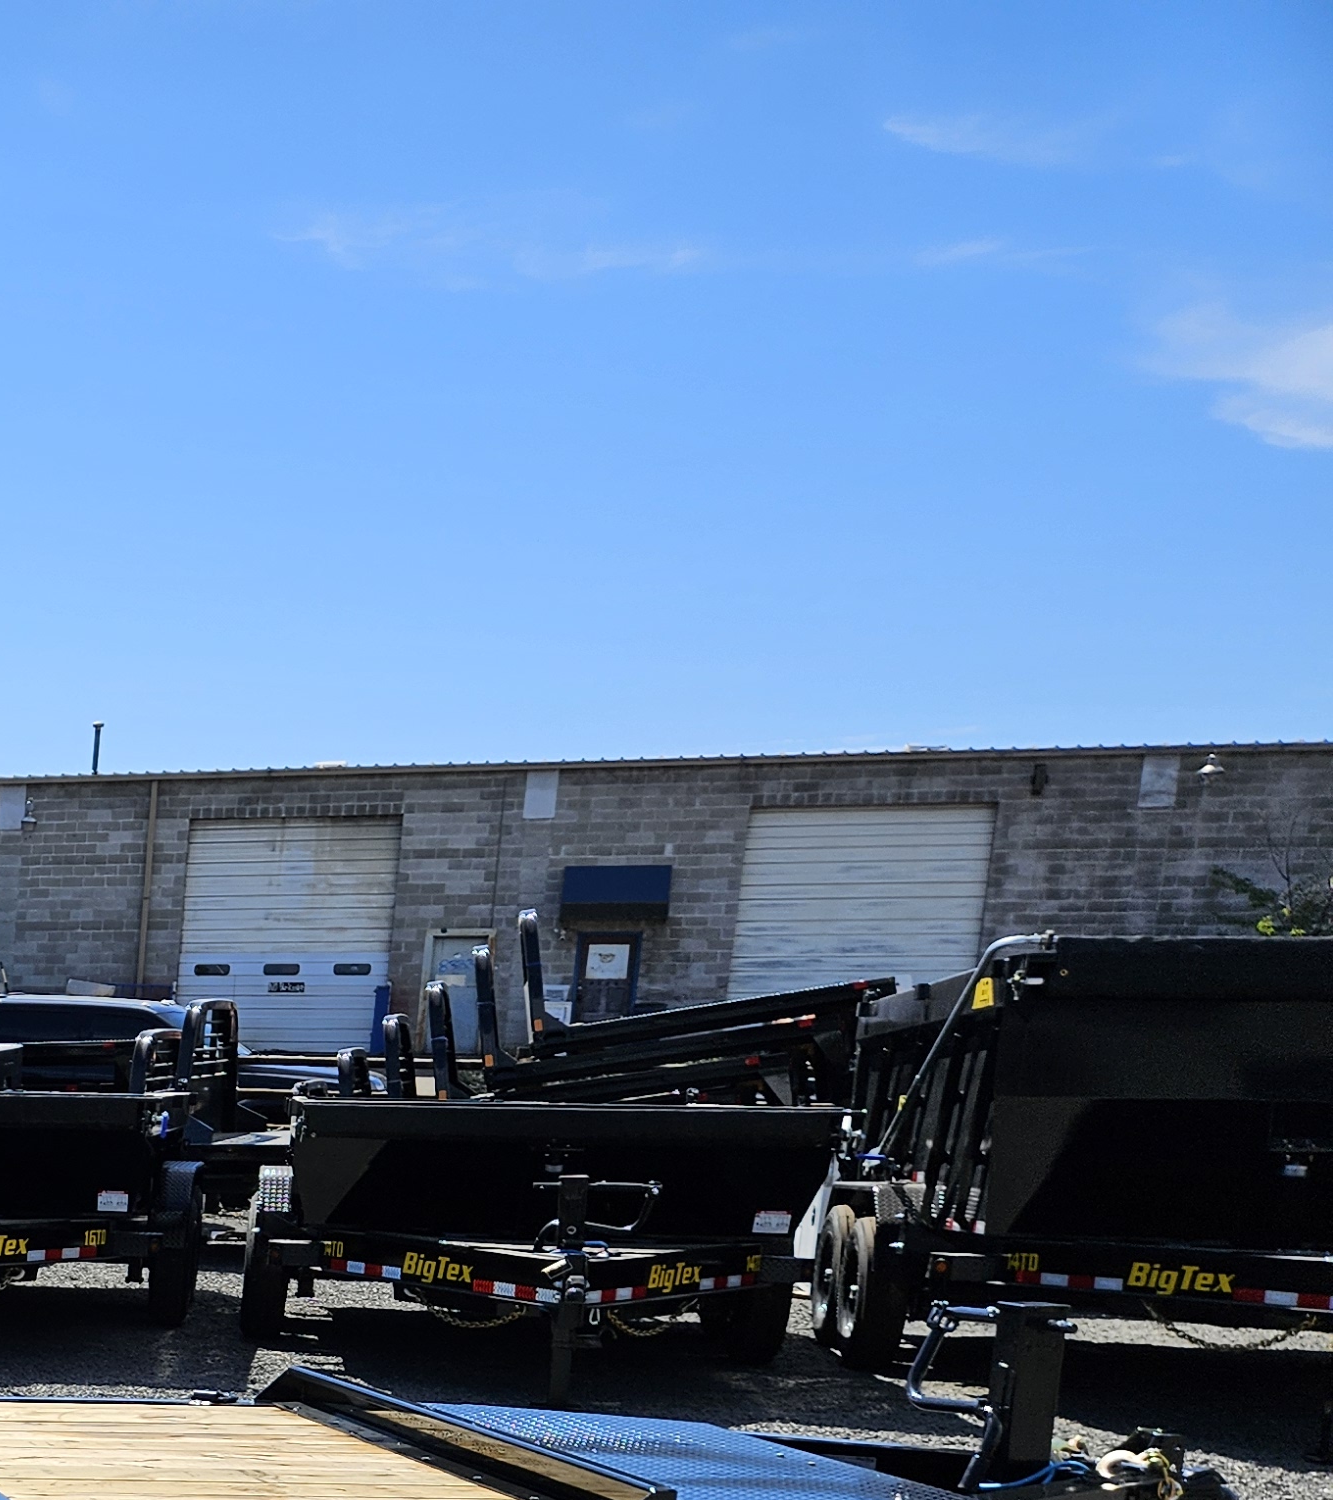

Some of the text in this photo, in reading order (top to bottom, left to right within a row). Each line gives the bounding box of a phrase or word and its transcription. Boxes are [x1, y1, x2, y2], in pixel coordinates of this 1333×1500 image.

[402, 1251, 474, 1284] BigTex
[647, 1262, 702, 1293] BigTex
[1126, 1261, 1236, 1296] BigTex
